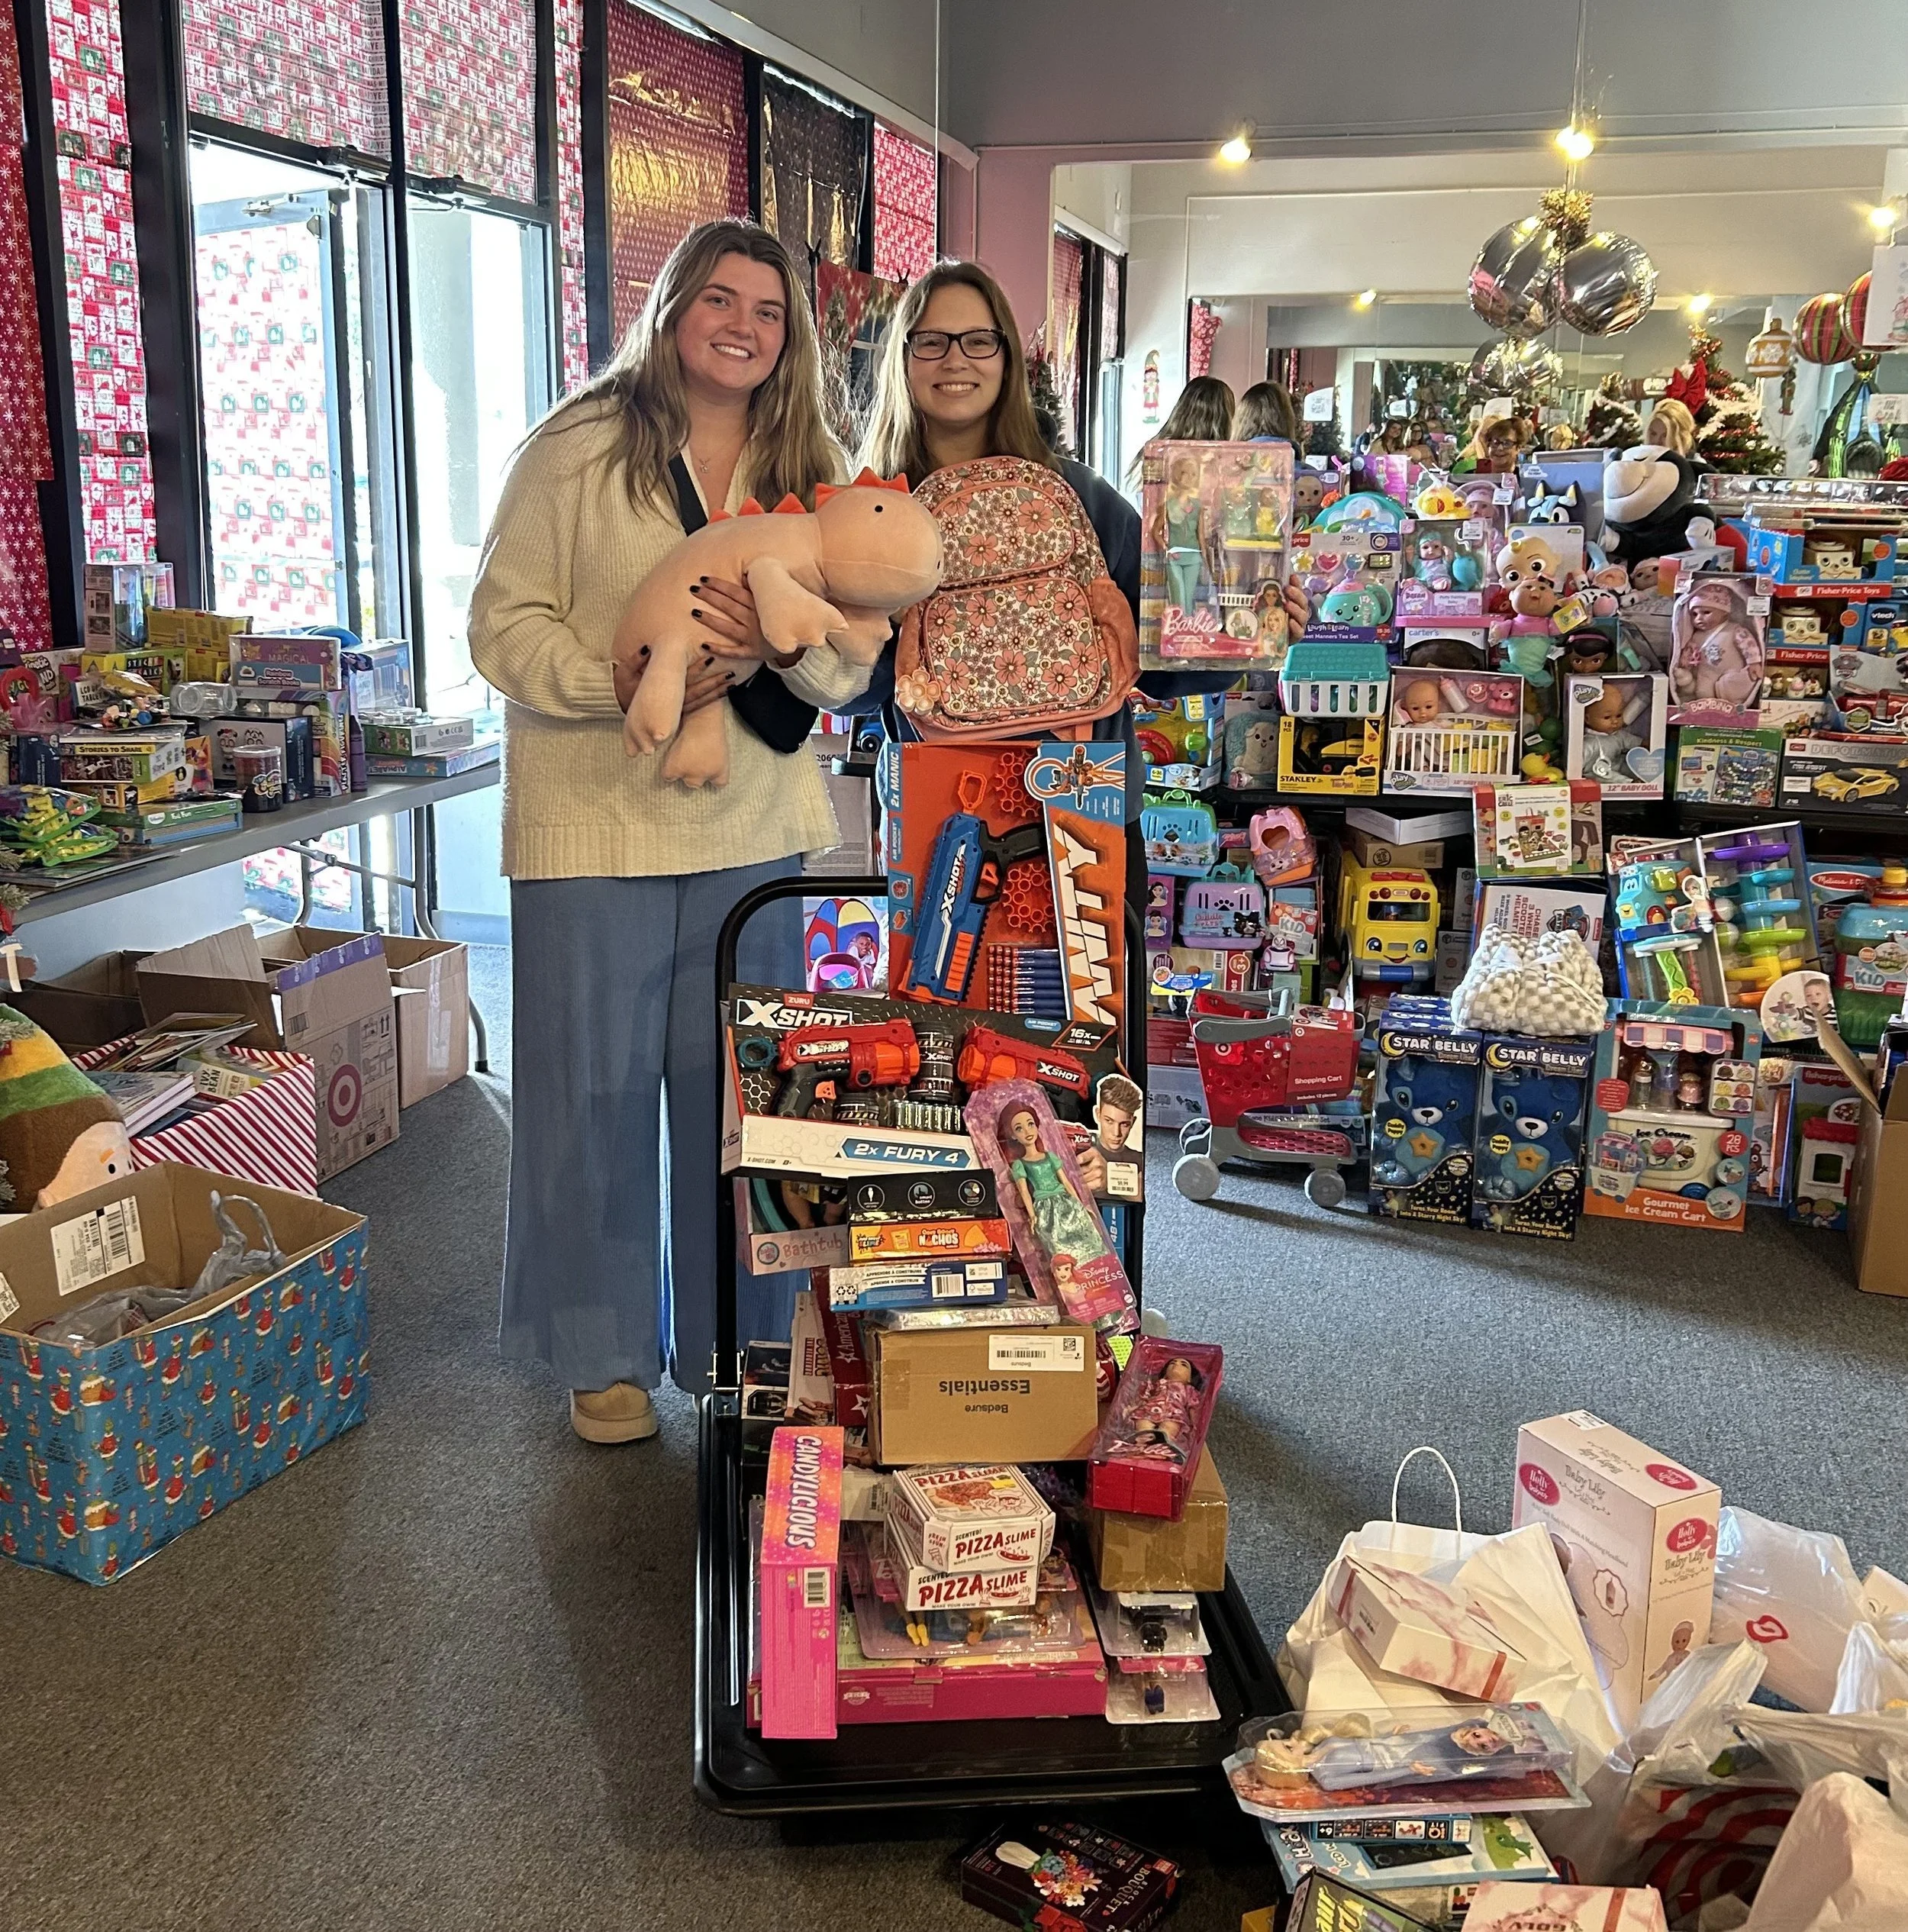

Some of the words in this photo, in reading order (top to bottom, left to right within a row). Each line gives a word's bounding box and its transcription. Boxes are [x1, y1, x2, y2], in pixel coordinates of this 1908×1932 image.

[1162, 607, 1218, 637] Barbie
[269, 653, 313, 664] MAGICAL
[1781, 650, 1828, 660] Fisher-Price
[1735, 738, 1763, 747] Respect
[890, 752, 900, 790] MANIC
[1280, 775, 1317, 783] STANLEY
[891, 795, 900, 808] 2x
[1512, 894, 1522, 930] HELMET
[1280, 919, 1305, 934] KID
[1533, 908, 1542, 938] CHASE
[1855, 970, 1886, 987] KID
[788, 996, 811, 1006] ZURU
[1393, 1036, 1429, 1050] STAR
[1435, 1040, 1478, 1054] BELLY
[1498, 1048, 1536, 1063] STAR
[1542, 1053, 1587, 1068] BELLY
[1636, 1128, 1652, 1138] Ice
[1655, 1127, 1693, 1140] Cream
[1726, 1134, 1742, 1145] 28
[854, 1143, 878, 1156] 2x
[882, 1146, 942, 1162] FURY
[944, 1150, 960, 1163] 4
[1643, 1197, 1690, 1211] Gourmet
[1418, 1212, 1436, 1221] Starry
[1436, 1214, 1452, 1223] Night
[1625, 1205, 1640, 1214] Ice
[1642, 1208, 1679, 1219] Cream
[1681, 1211, 1707, 1222] Cart
[918, 1234, 959, 1247] NACHOS
[1522, 1227, 1541, 1236] Starry
[1541, 1229, 1557, 1237] Night
[782, 1237, 842, 1260] Bathtub
[1074, 1270, 1124, 1291] PRINCESS
[1084, 1266, 1110, 1279] Disney
[833, 1312, 855, 1352] American
[939, 1379, 1031, 1396] Essentials
[964, 1404, 1009, 1413] Bedsure
[915, 1470, 972, 1488] PIZZA
[1529, 1469, 1549, 1489] Holly
[1565, 1464, 1588, 1486] Baby
[1588, 1478, 1607, 1499] Lily
[785, 1434, 823, 1550] CANDYLICIOUS
[956, 1528, 982, 1541] SCENTED!
[1678, 1524, 1697, 1537] Holly
[956, 1531, 1004, 1559] PIZZA
[1005, 1528, 1036, 1545] SLIME
[1665, 1555, 1688, 1571] Baby
[1688, 1550, 1707, 1564] Lily
[918, 1573, 984, 1607] PIZZA
[985, 1570, 1027, 1592] SLIME
[1319, 1827, 1333, 1835] 6+
[1333, 1850, 1352, 1868] LCD
[1104, 1867, 1151, 1913] BOUQUET
[1123, 1880, 1149, 1905] BLOCK
